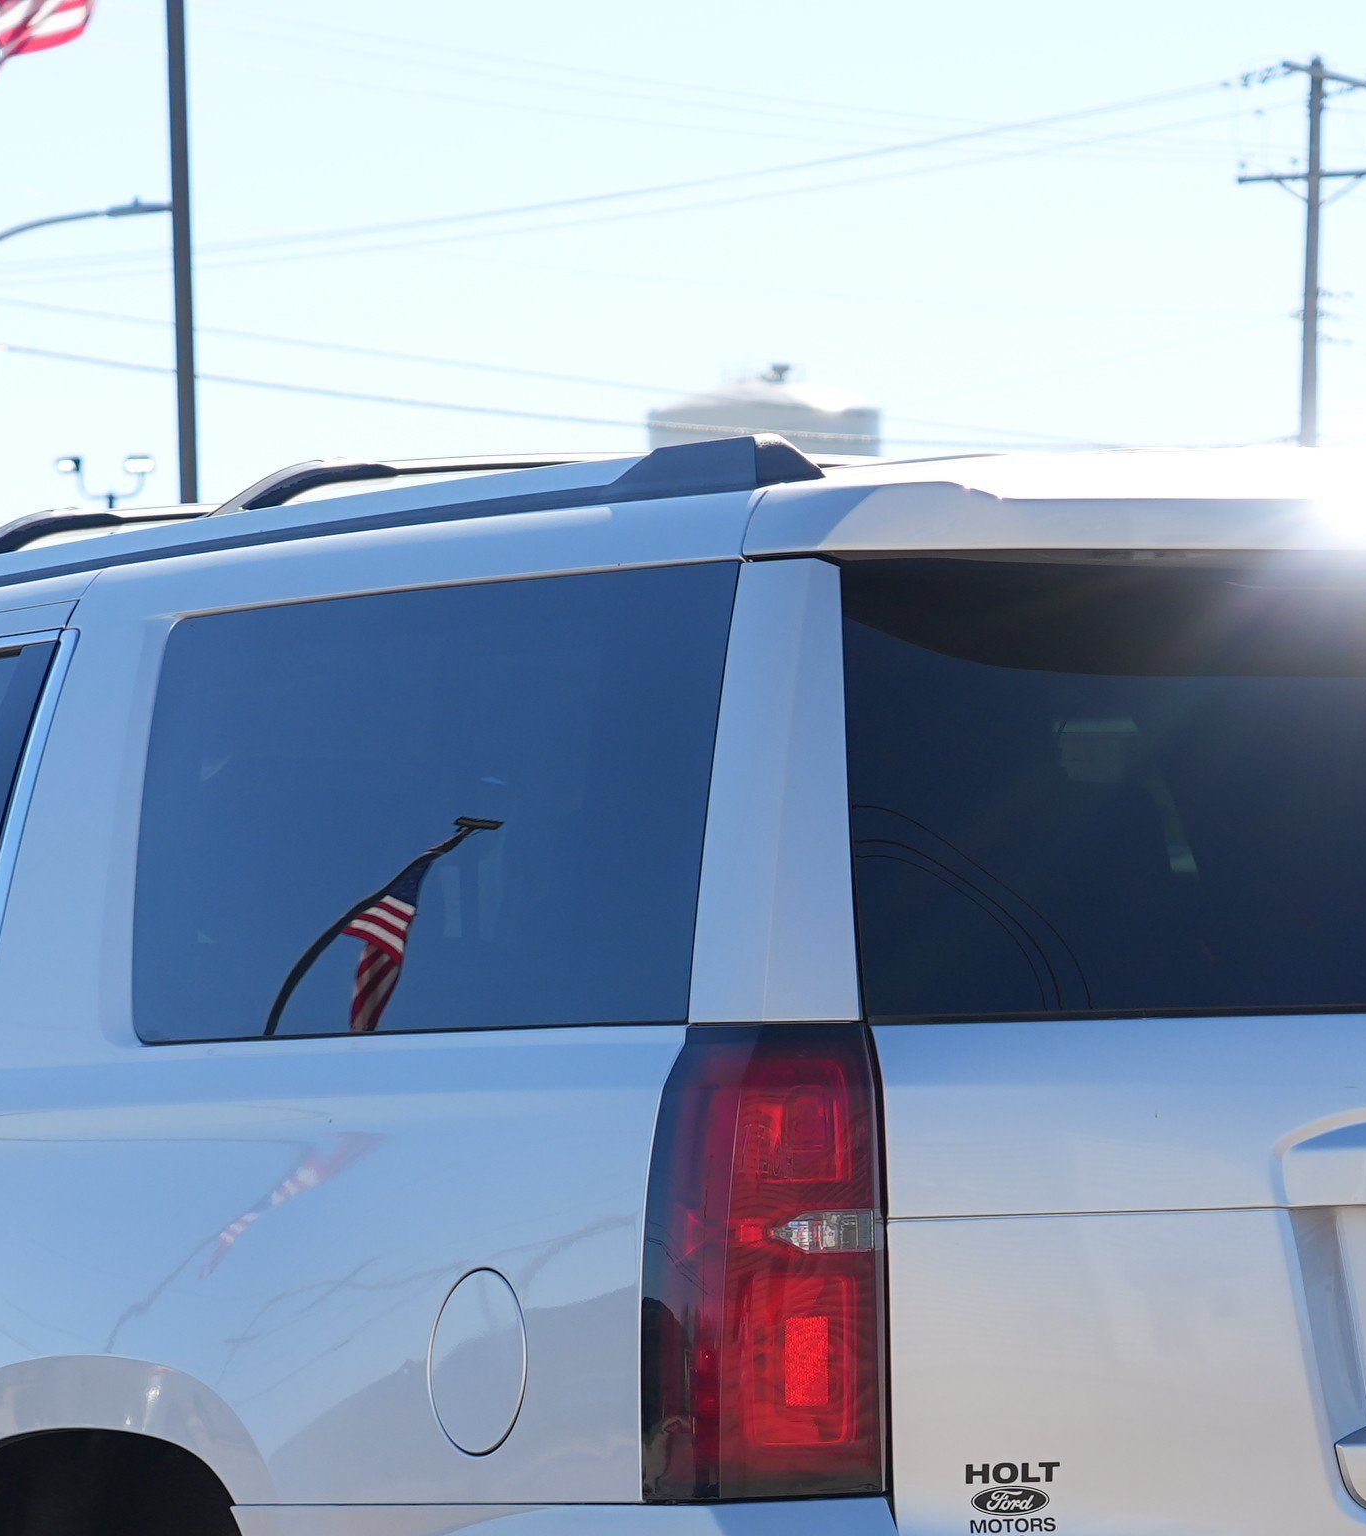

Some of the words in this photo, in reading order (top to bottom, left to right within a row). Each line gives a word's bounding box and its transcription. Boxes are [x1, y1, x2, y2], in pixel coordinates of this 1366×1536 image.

[965, 1462, 1060, 1484] HOLT
[986, 1490, 1035, 1511] Ford
[969, 1517, 1057, 1534] MOTORS
